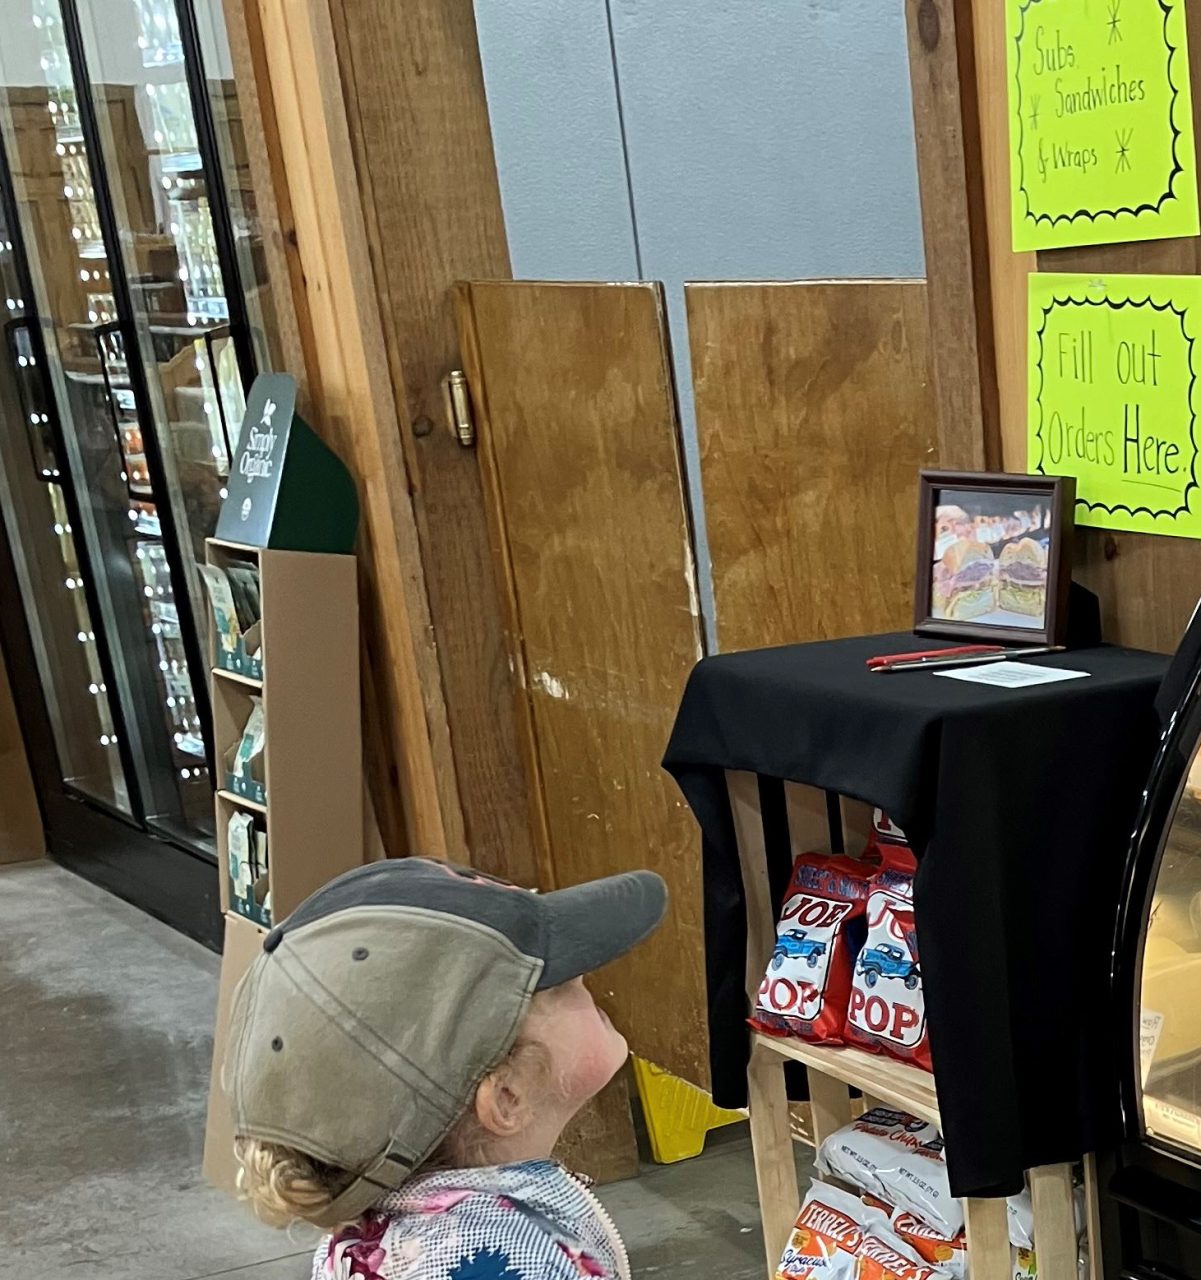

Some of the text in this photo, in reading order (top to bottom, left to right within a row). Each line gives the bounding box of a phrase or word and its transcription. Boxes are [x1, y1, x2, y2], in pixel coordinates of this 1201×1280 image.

[1054, 64, 1146, 118] Sandwiches
[1052, 141, 1098, 174] Wraps
[1058, 329, 1162, 386] Fill out
[1049, 403, 1187, 475] Orders Here.
[782, 897, 850, 928] JOE
[850, 986, 920, 1041] POP
[801, 1204, 864, 1249] TERRELL'S
